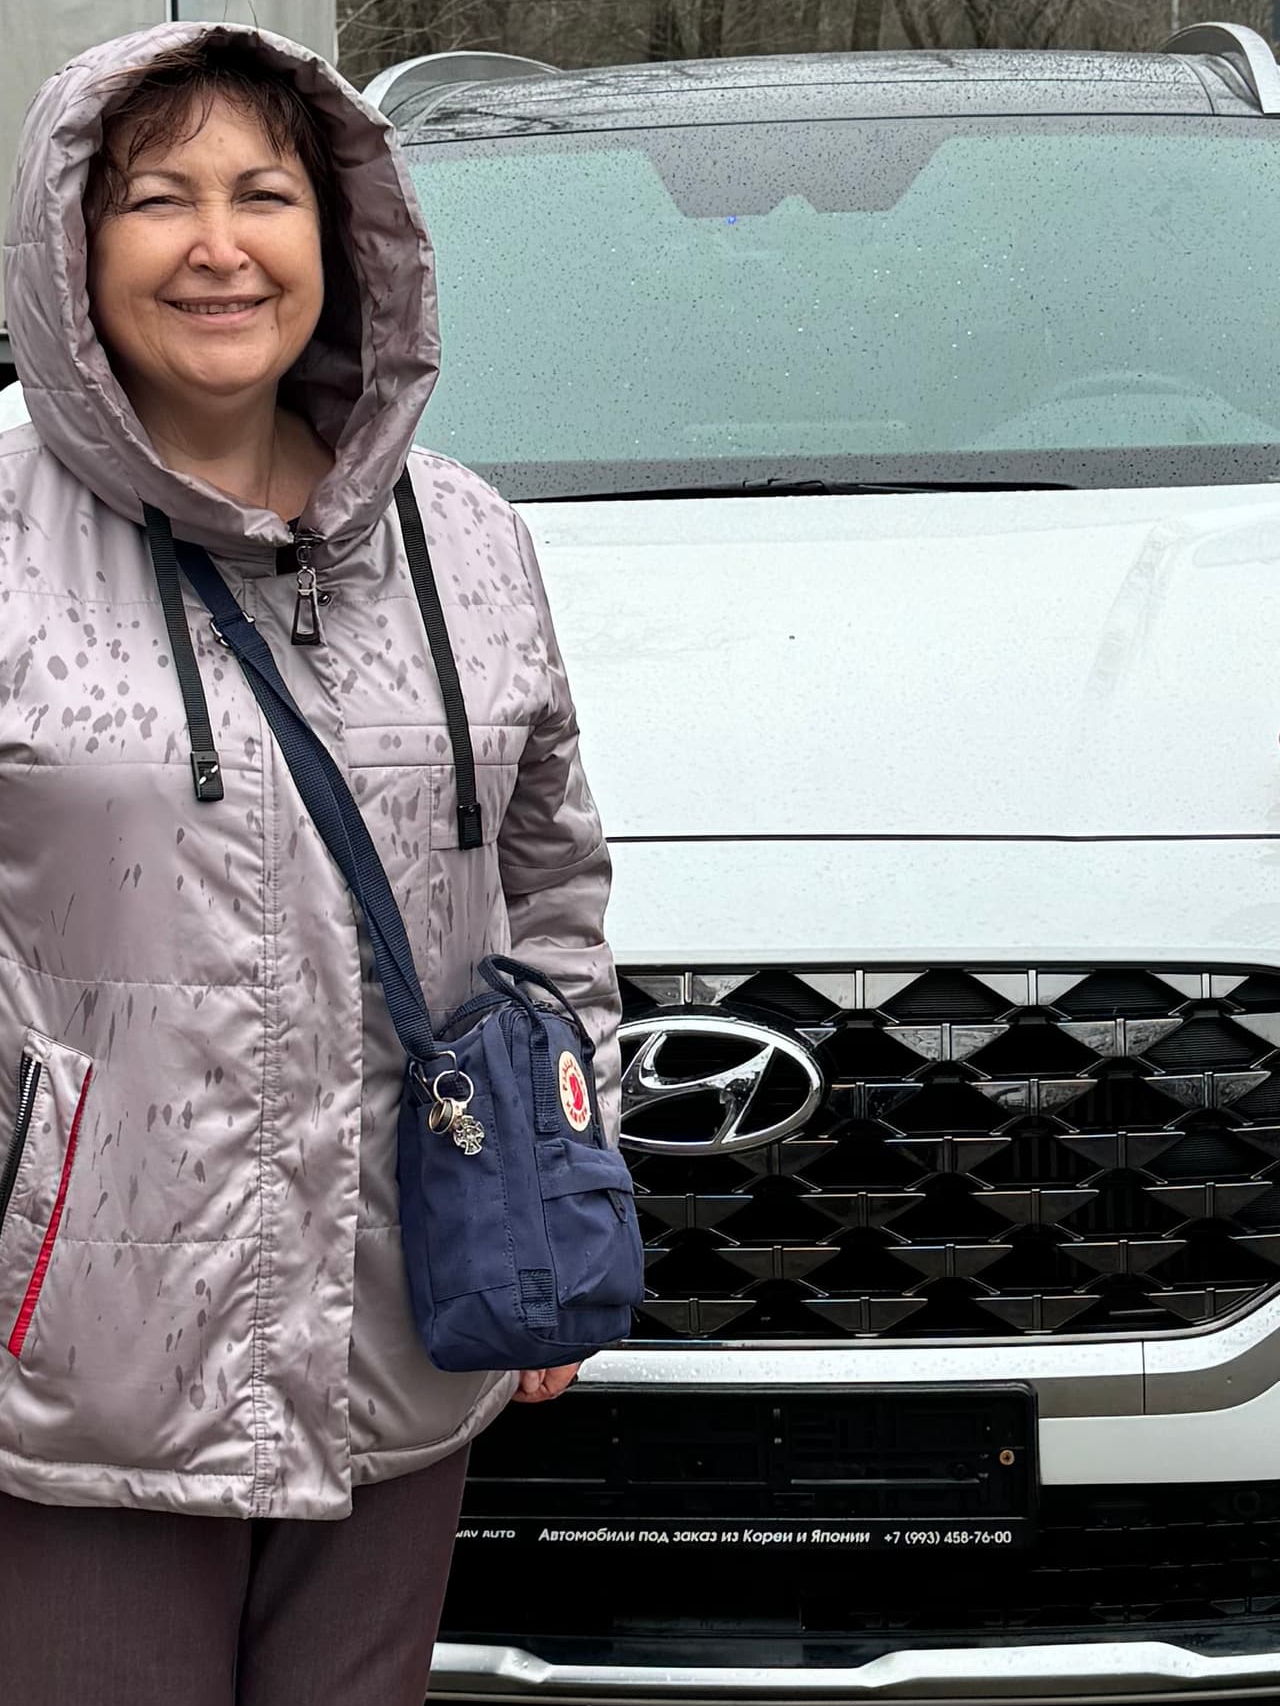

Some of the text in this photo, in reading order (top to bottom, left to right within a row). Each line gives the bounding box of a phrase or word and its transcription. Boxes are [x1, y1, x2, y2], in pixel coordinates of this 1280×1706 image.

[482, 1529, 516, 1539] AUTO
[538, 1527, 870, 1545] Автомобили под заказ из Кореи и Японии
[883, 1530, 1012, 1545] +7 (993) 458-76-00
